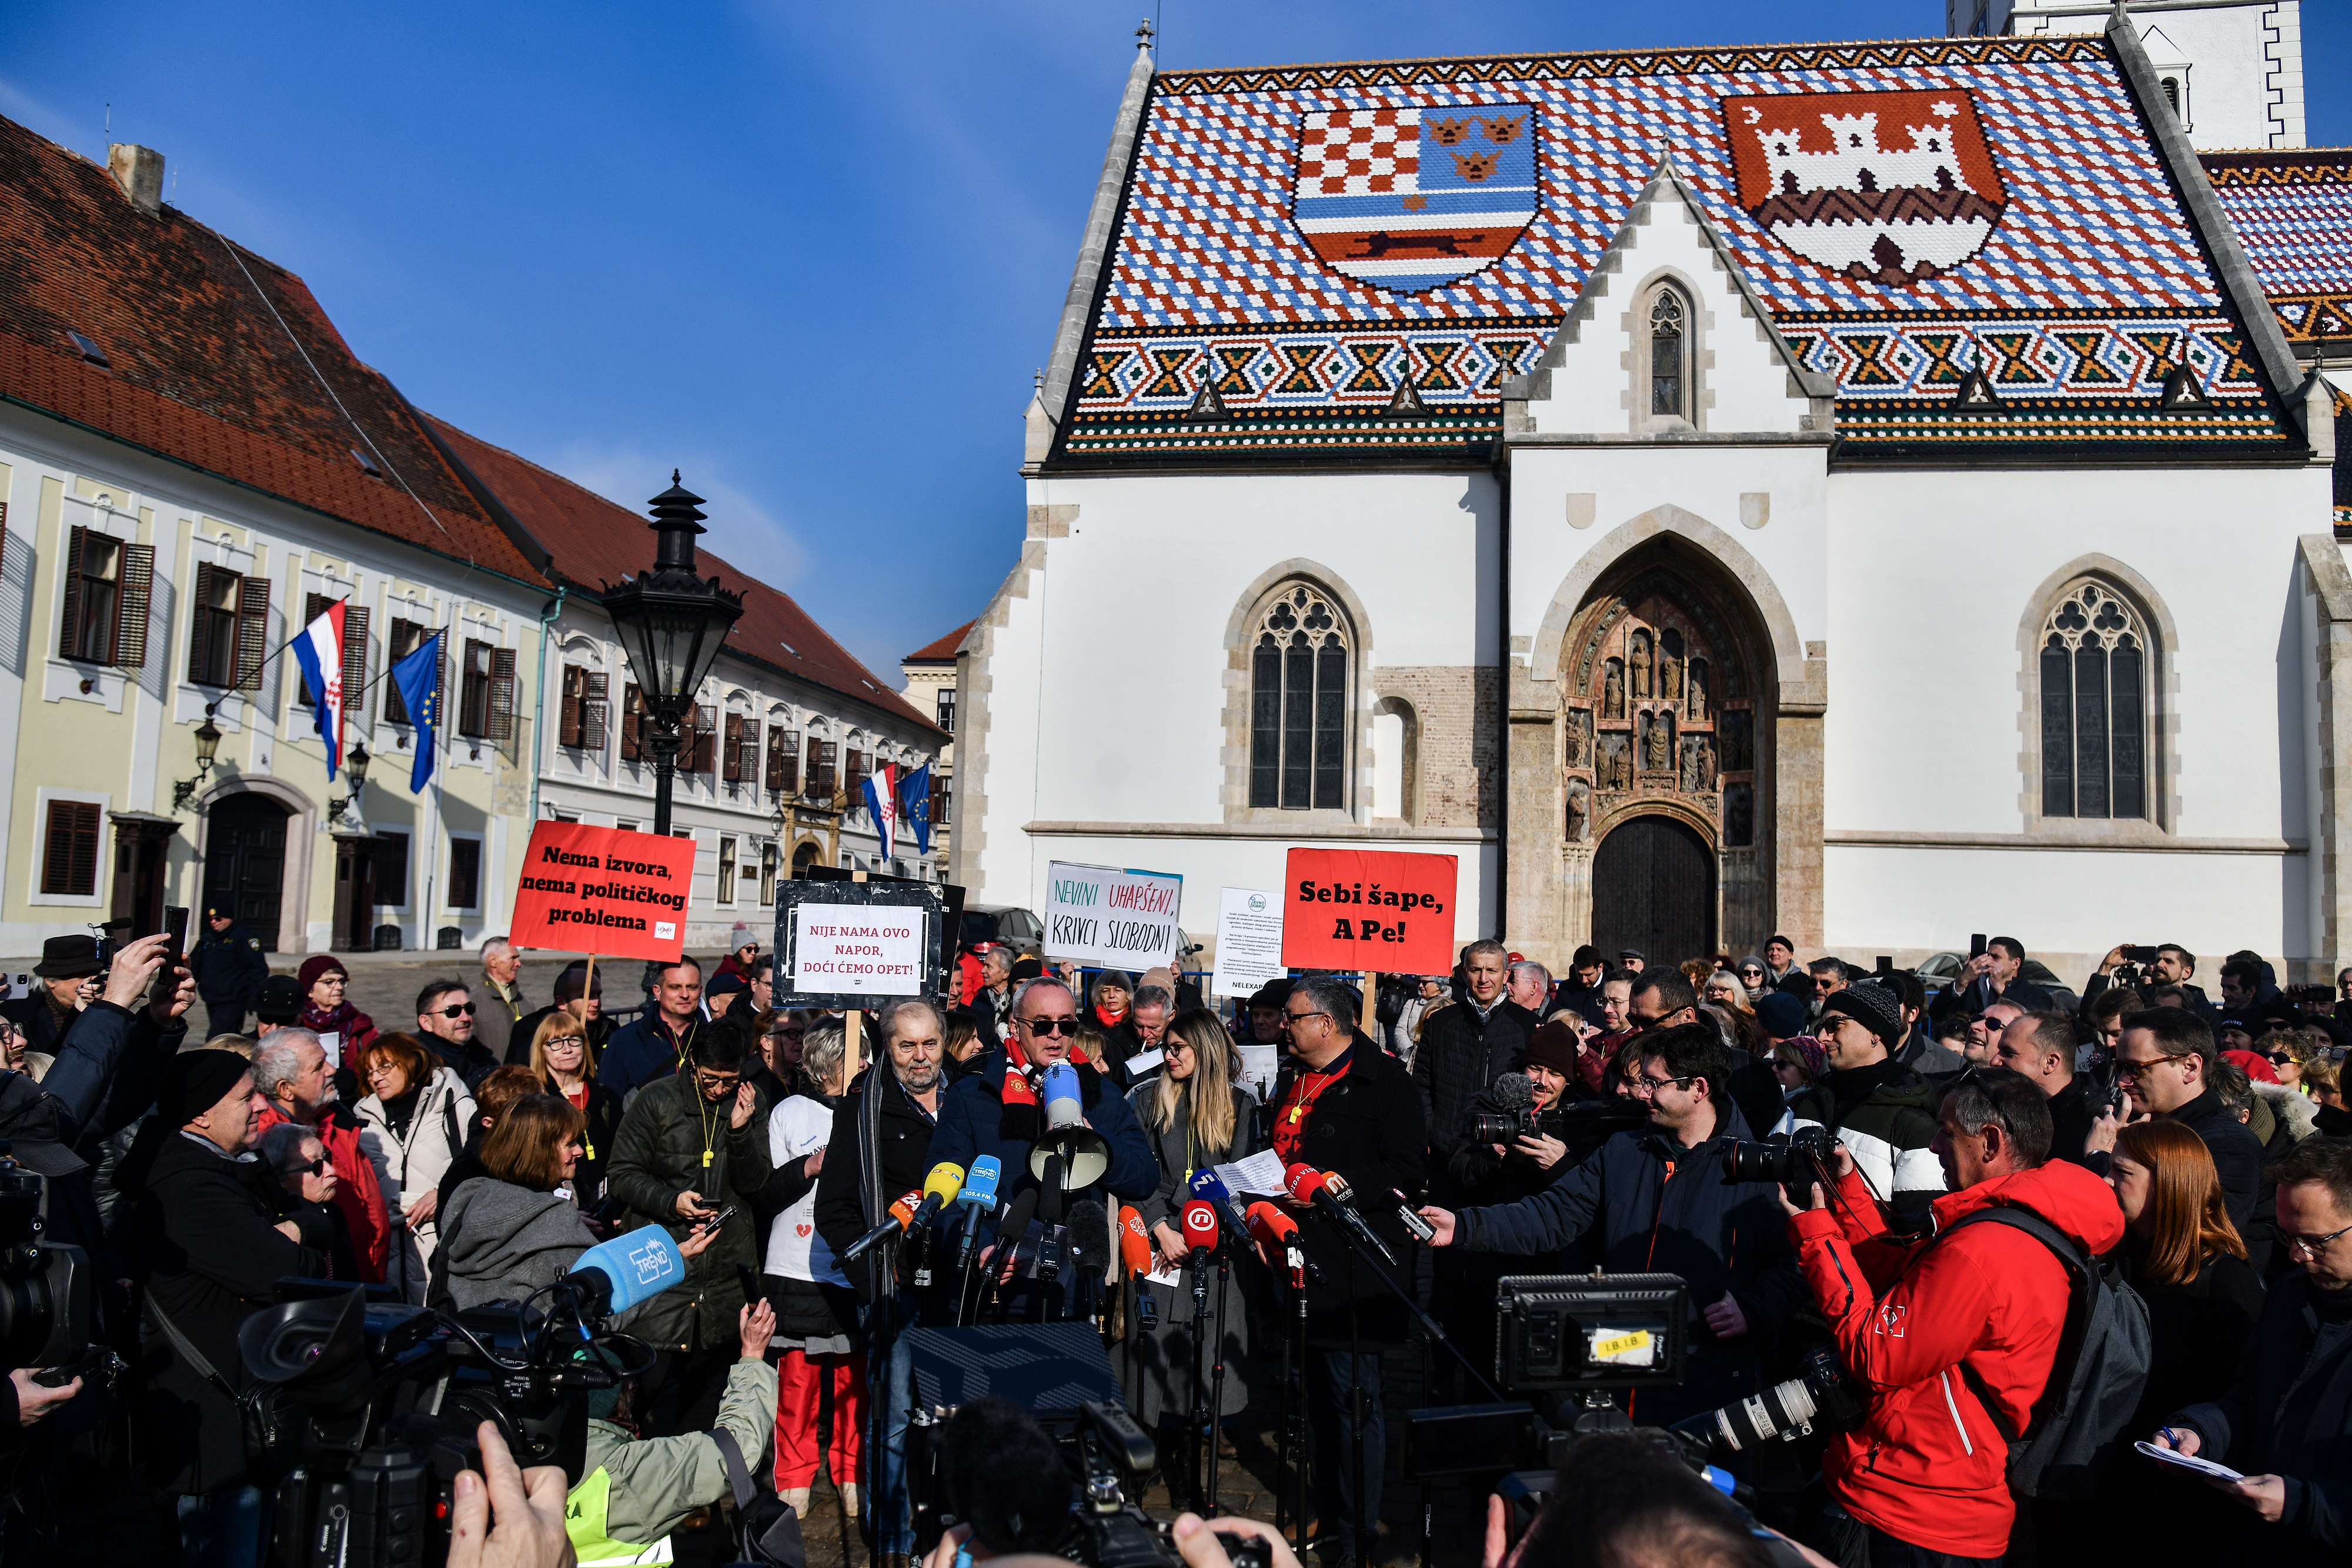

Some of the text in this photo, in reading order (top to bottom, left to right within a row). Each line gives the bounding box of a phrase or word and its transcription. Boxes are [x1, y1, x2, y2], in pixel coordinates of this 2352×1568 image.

[542, 846, 672, 881] Nema izvora,
[522, 876, 686, 911] nema političkog
[1055, 880, 1174, 917] NEVINI UHAPŠENI,
[1299, 880, 1444, 914] Sebi šape,
[547, 908, 646, 931] problema
[1332, 918, 1406, 943] A Pe!
[810, 925, 910, 938] NIJE NAMA OVO
[1053, 914, 1171, 954] KRIVCI SLOBODNI
[835, 945, 883, 958] NAPOR,
[803, 961, 913, 975] DOĆI ĆEMO OPET!
[1192, 1173, 1215, 1192] N1
[900, 1192, 921, 1212] 24
[636, 1251, 668, 1273] TREND
